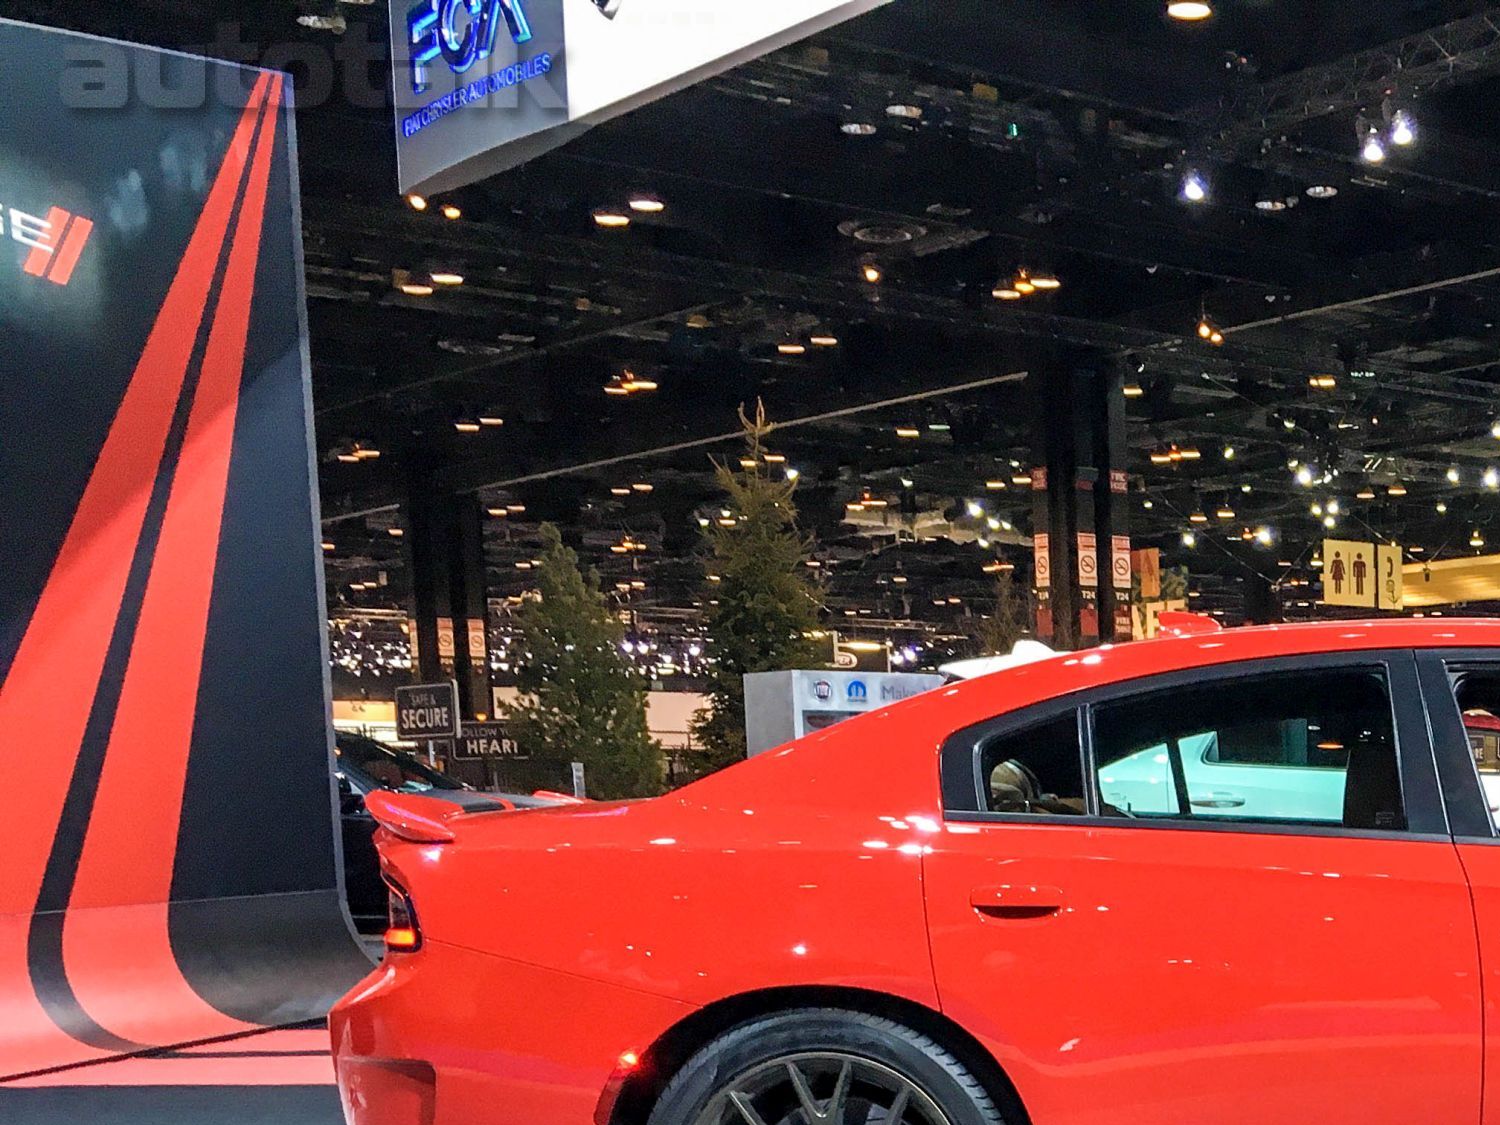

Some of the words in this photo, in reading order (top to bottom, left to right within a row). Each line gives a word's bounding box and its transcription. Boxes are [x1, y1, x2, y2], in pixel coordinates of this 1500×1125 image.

[403, 113, 422, 138] FIAT
[421, 87, 468, 125] CHRYSLER
[467, 53, 552, 101] AUTOMOBILES
[402, 707, 449, 729] SECURE
[466, 738, 519, 755] HEART
